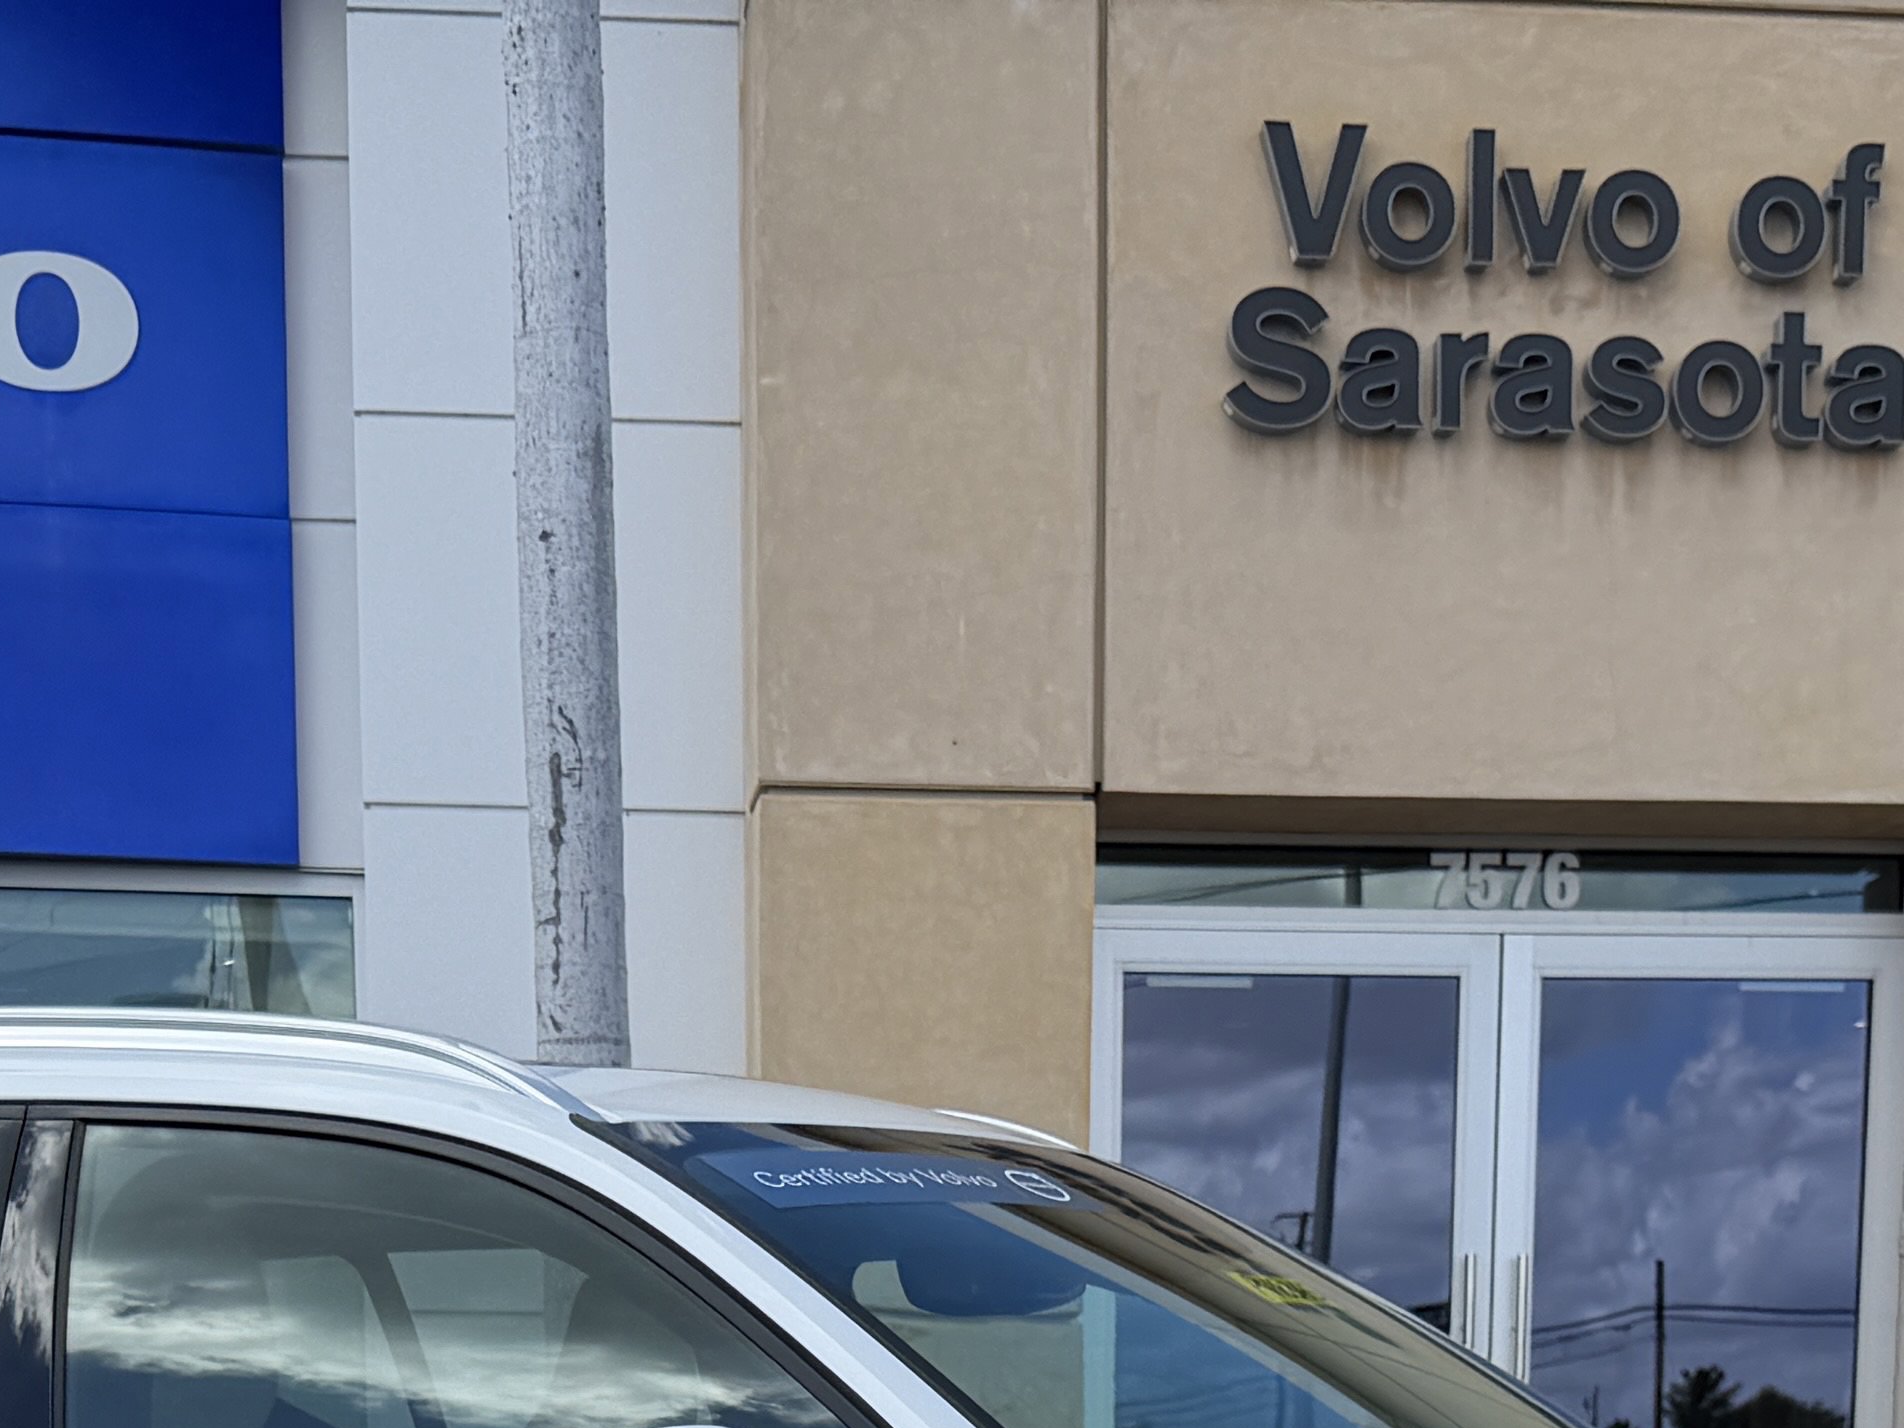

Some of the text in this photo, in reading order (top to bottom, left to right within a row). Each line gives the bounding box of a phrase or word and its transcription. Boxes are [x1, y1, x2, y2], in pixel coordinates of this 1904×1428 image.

[1261, 119, 1886, 286] Volvo of
[1429, 851, 1581, 910] 7576
[753, 1167, 885, 1188] Certified
[876, 1168, 925, 1189] by
[913, 1168, 999, 1189] Volvo
